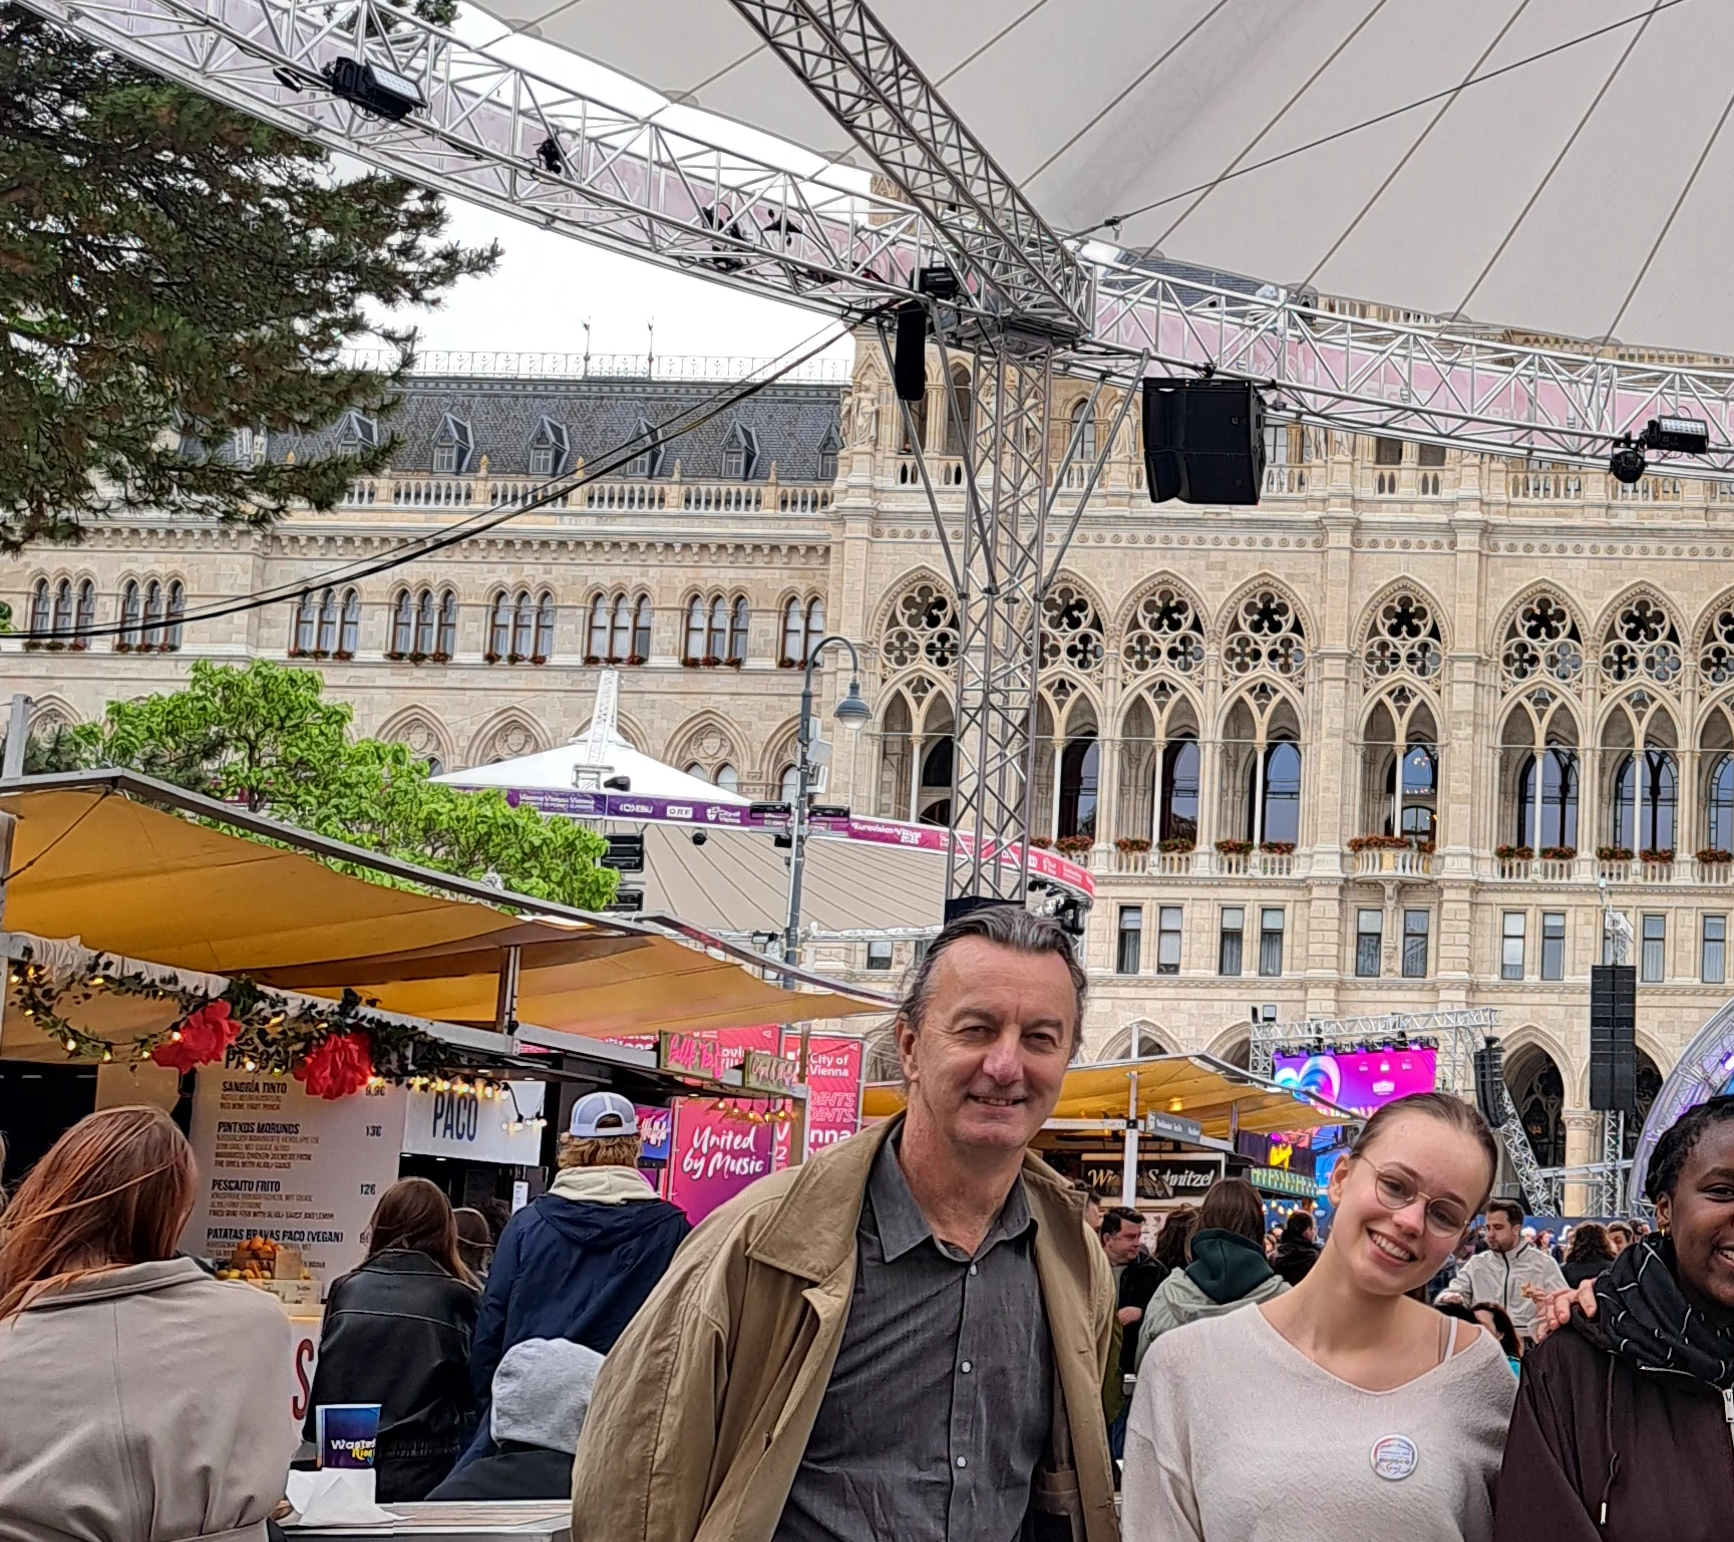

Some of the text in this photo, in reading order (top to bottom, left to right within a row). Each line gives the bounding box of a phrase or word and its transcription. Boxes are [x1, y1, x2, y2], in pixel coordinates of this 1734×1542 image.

[669, 807, 691, 817] ORF
[810, 1053, 849, 1066] City of
[809, 1064, 849, 1077] Vienna
[432, 1089, 479, 1142] PACO
[693, 1125, 756, 1152] United
[683, 1149, 765, 1181] by Music
[206, 1227, 244, 1240] PATATAS
[281, 1230, 306, 1242] PACO
[306, 1230, 344, 1244] (VEGAN)
